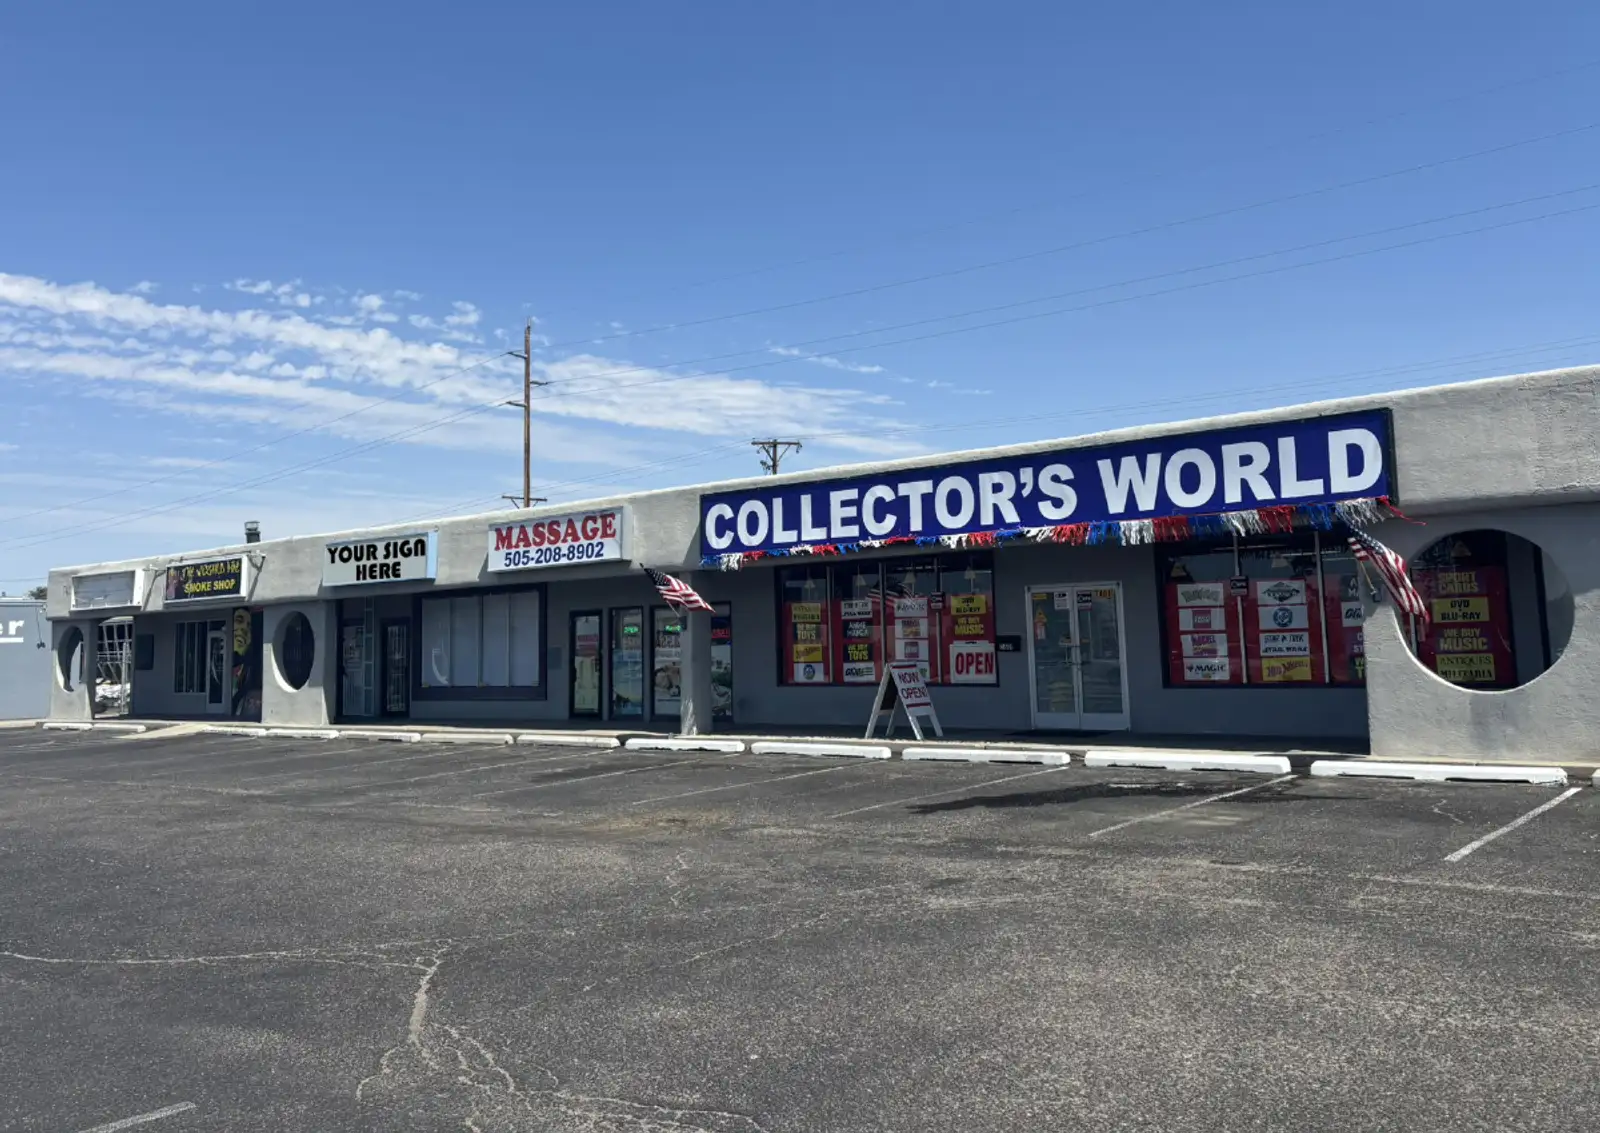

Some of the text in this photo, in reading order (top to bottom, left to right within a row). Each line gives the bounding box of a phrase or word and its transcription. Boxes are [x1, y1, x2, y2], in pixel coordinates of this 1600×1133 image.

[704, 428, 1383, 550] COLLECTOR'S WORLD
[494, 512, 616, 551] MASSAGE
[327, 538, 426, 564] YOUR SIGN
[504, 541, 605, 568] 505-208-8902
[356, 562, 401, 582] HERE
[184, 579, 237, 594] SMOKE SHOP
[1440, 582, 1479, 593] CARDS
[1450, 599, 1470, 608] DVD
[1441, 612, 1481, 621] BLU-RAY
[0, 620, 24, 635] r
[955, 624, 984, 635] MUSIC
[1461, 628, 1480, 637] BUY
[798, 630, 816, 640] TOYS
[1440, 638, 1488, 650] MUSIC
[848, 650, 868, 661] TOYS
[955, 652, 994, 675] OPEN
[1194, 664, 1226, 672] MAGIC
[898, 672, 920, 684] NOW
